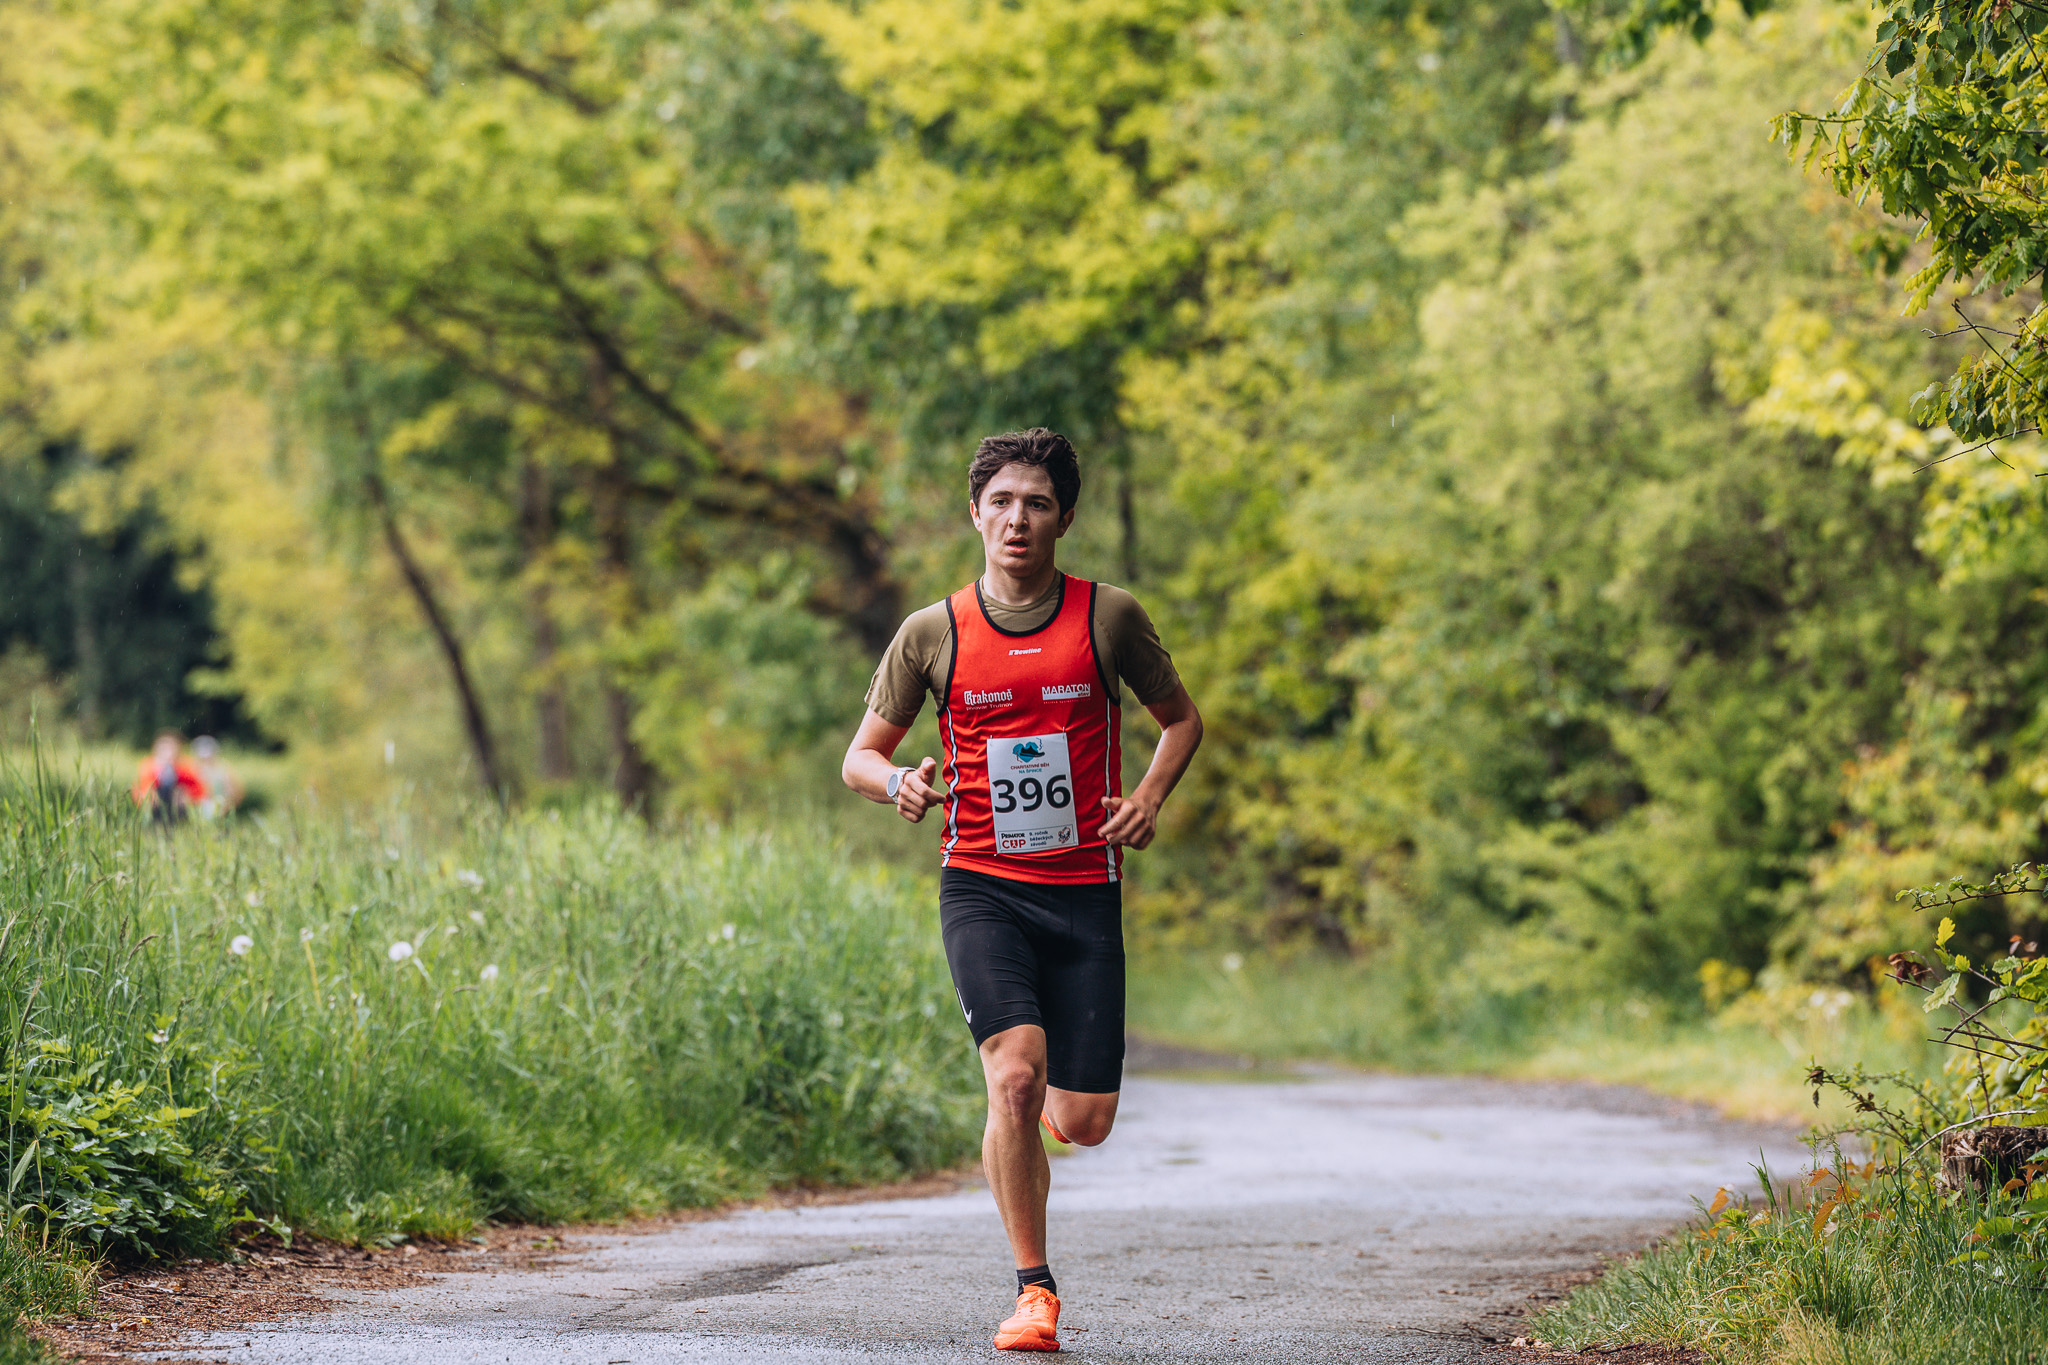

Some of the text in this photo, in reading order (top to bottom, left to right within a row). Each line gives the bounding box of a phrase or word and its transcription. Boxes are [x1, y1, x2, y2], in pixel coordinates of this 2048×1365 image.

[1042, 683, 1090, 695] MARATON
[992, 774, 1071, 813] 396
[1002, 839, 1026, 849] CUP
